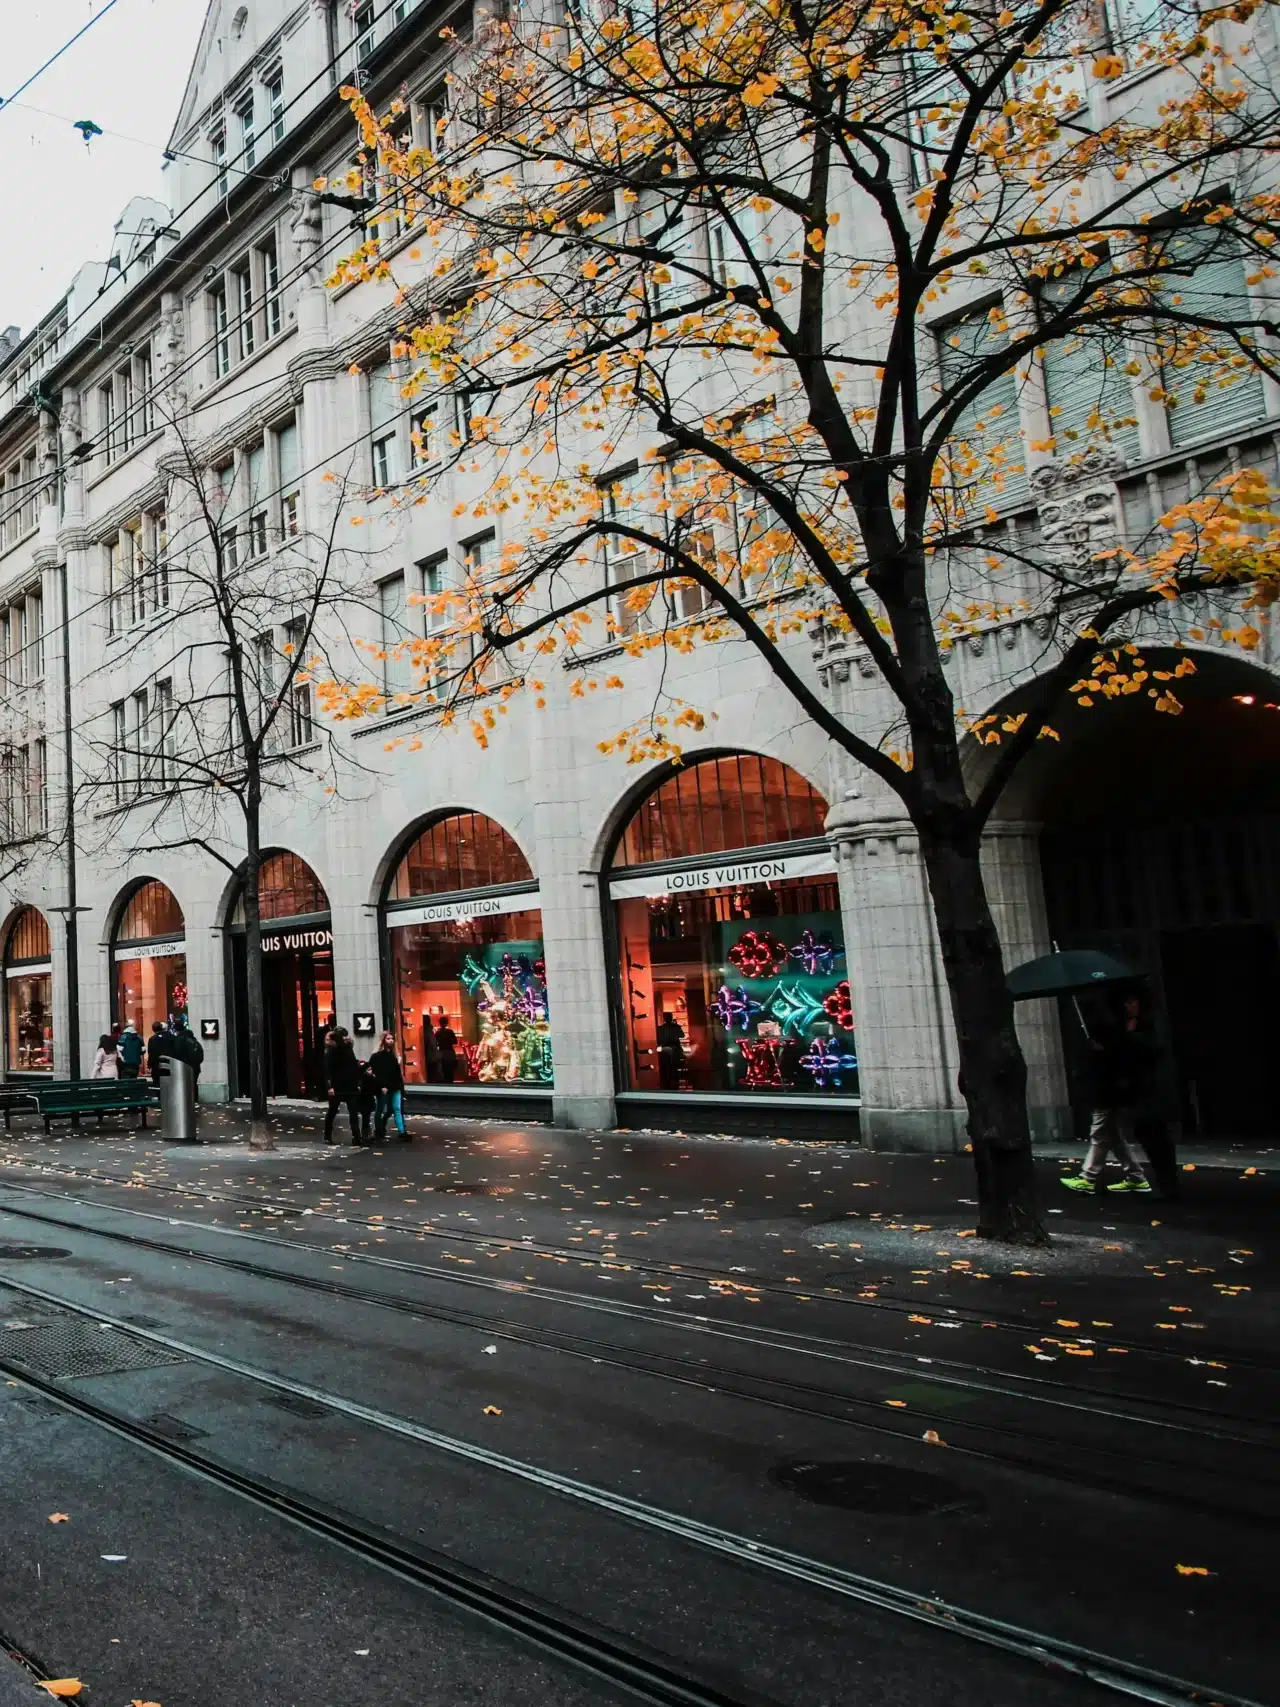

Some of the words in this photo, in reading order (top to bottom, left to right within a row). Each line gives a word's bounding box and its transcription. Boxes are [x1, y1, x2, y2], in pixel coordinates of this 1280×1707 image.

[666, 872, 710, 890] LOUIS
[715, 862, 786, 883] VUITTON
[423, 906, 452, 920] LOUIS
[455, 899, 501, 915] VUITTON
[151, 944, 176, 955] VUITTON
[260, 936, 281, 952] UIS
